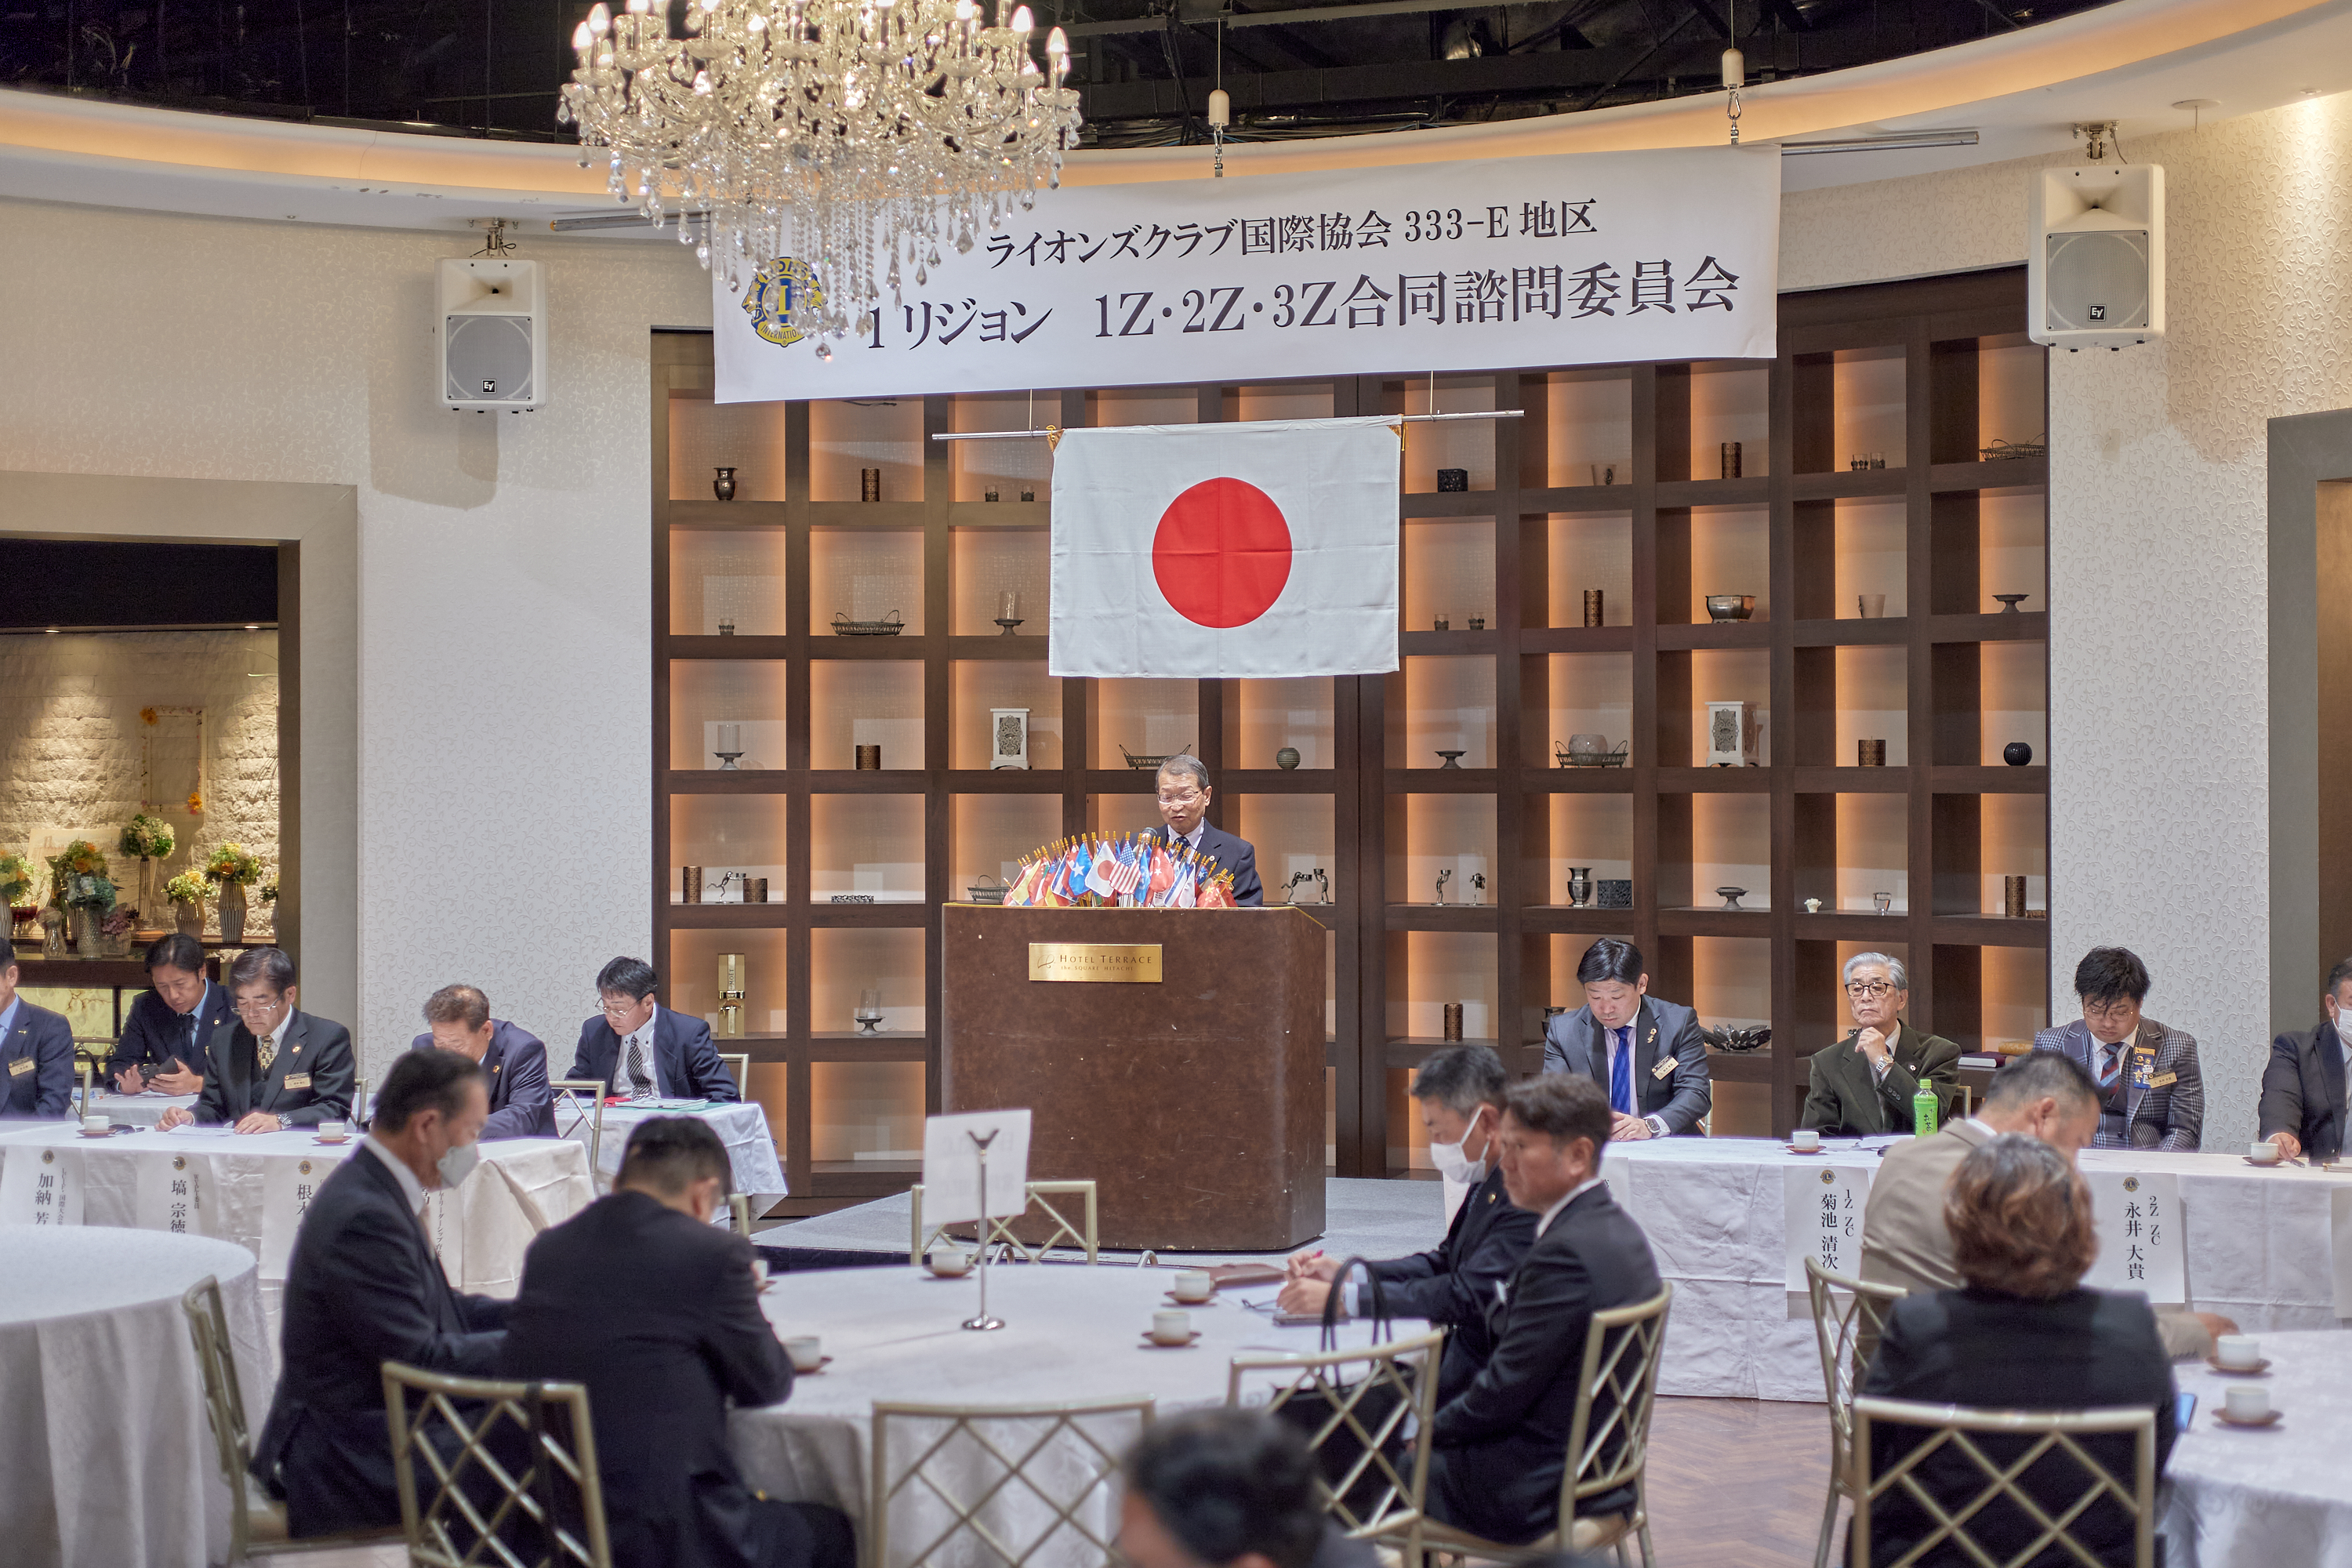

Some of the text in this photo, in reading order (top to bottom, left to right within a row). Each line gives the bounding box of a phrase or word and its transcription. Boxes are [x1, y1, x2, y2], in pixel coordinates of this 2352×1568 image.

[985, 198, 1599, 270] ライオンズクラブ国際協会 333-E 地区
[1060, 954, 1152, 964] HOTEL TERRACE
[34, 1172, 53, 1205] 加納
[1844, 1189, 1854, 1237] 1Z ZC
[1820, 1194, 1838, 1270] 菊池 清次
[2124, 1202, 2145, 1280] 永井 大貴
[2149, 1196, 2161, 1246] 2Z ZC
